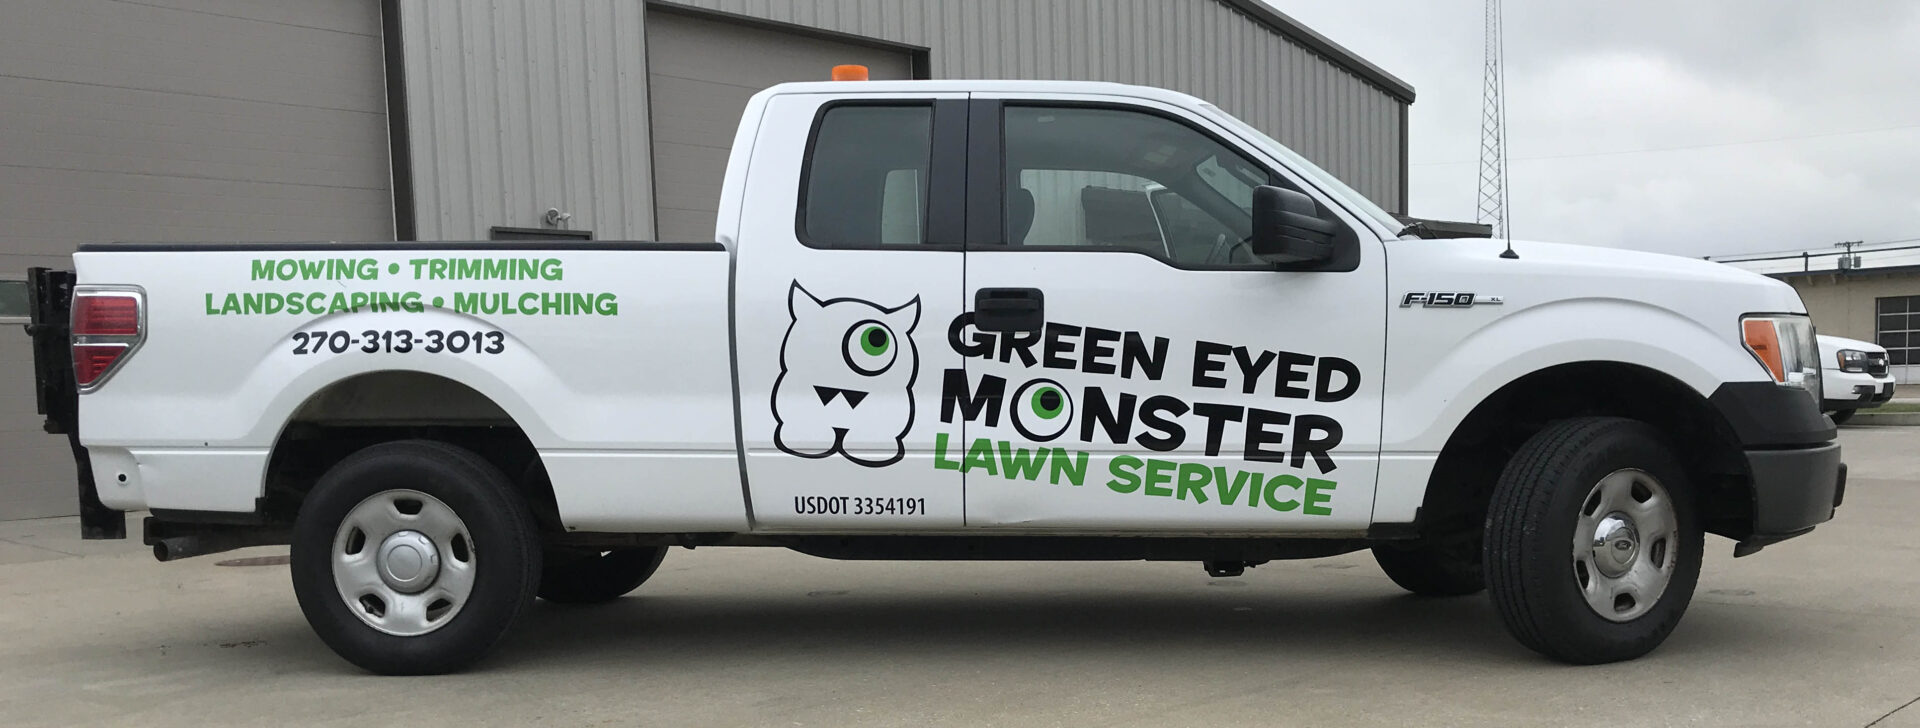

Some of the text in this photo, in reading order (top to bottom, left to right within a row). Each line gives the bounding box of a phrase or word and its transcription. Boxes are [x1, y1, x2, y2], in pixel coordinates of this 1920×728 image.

[251, 258, 563, 281] MOWING TRIMMING
[205, 291, 618, 316] LANDSCAPING MULCHING
[1401, 292, 1475, 306] F-150
[292, 330, 505, 355] 270-313-3013
[1191, 340, 1361, 403] EYED
[939, 368, 1344, 475] MONSTER
[934, 432, 1337, 516] LAWN SERVICE
[794, 495, 925, 516] USDOT 3354191
